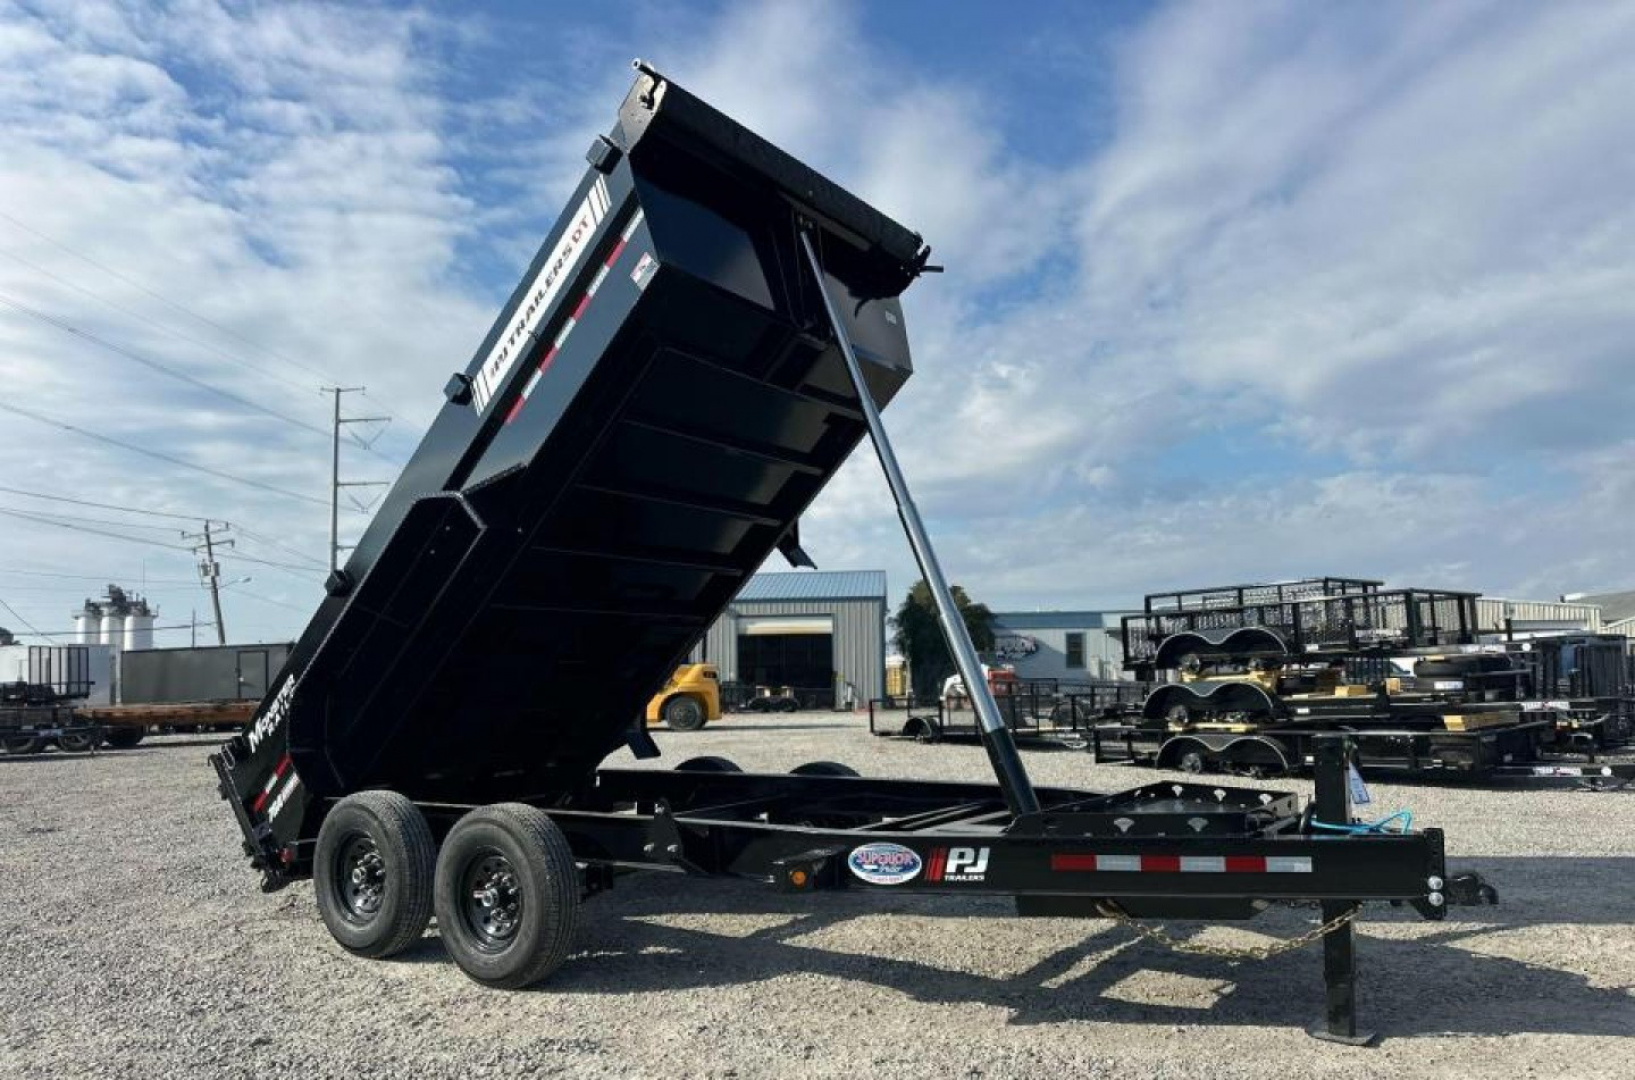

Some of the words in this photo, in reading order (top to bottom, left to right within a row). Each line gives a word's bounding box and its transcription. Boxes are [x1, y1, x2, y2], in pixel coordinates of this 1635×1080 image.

[508, 245, 572, 346] TRAILERS
[572, 216, 589, 244] DT
[945, 847, 991, 873] PJ
